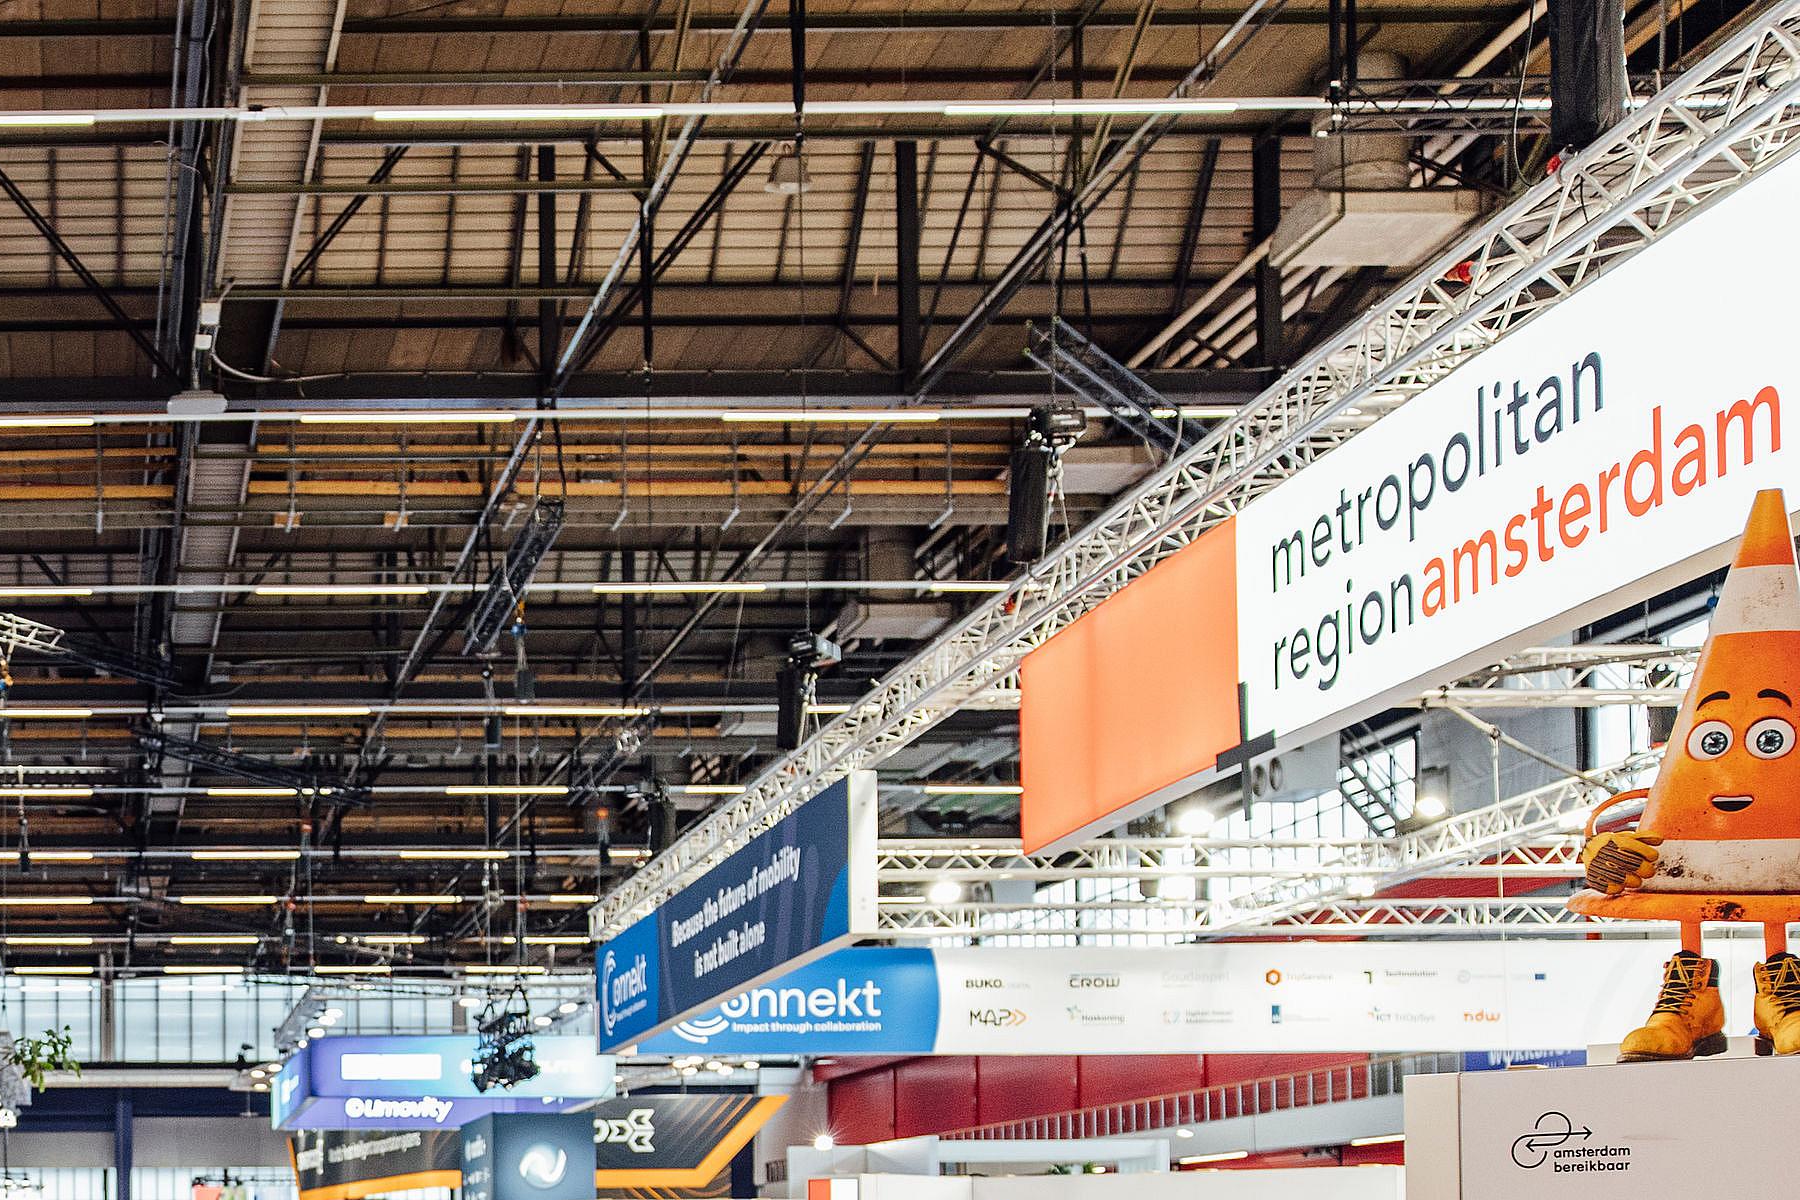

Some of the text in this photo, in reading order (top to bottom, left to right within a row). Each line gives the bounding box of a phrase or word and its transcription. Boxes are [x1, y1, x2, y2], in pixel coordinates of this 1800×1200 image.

[1271, 351, 1604, 594] metropolitan
[671, 845, 801, 948] Because the future of mobility
[694, 919, 766, 979] is not built alone
[1069, 977, 1121, 988] CROW
[732, 1021, 882, 1034] Impact through collaboration
[1553, 1145, 1631, 1159] amsterdam
[1553, 1160, 1631, 1173] bereikbaar
